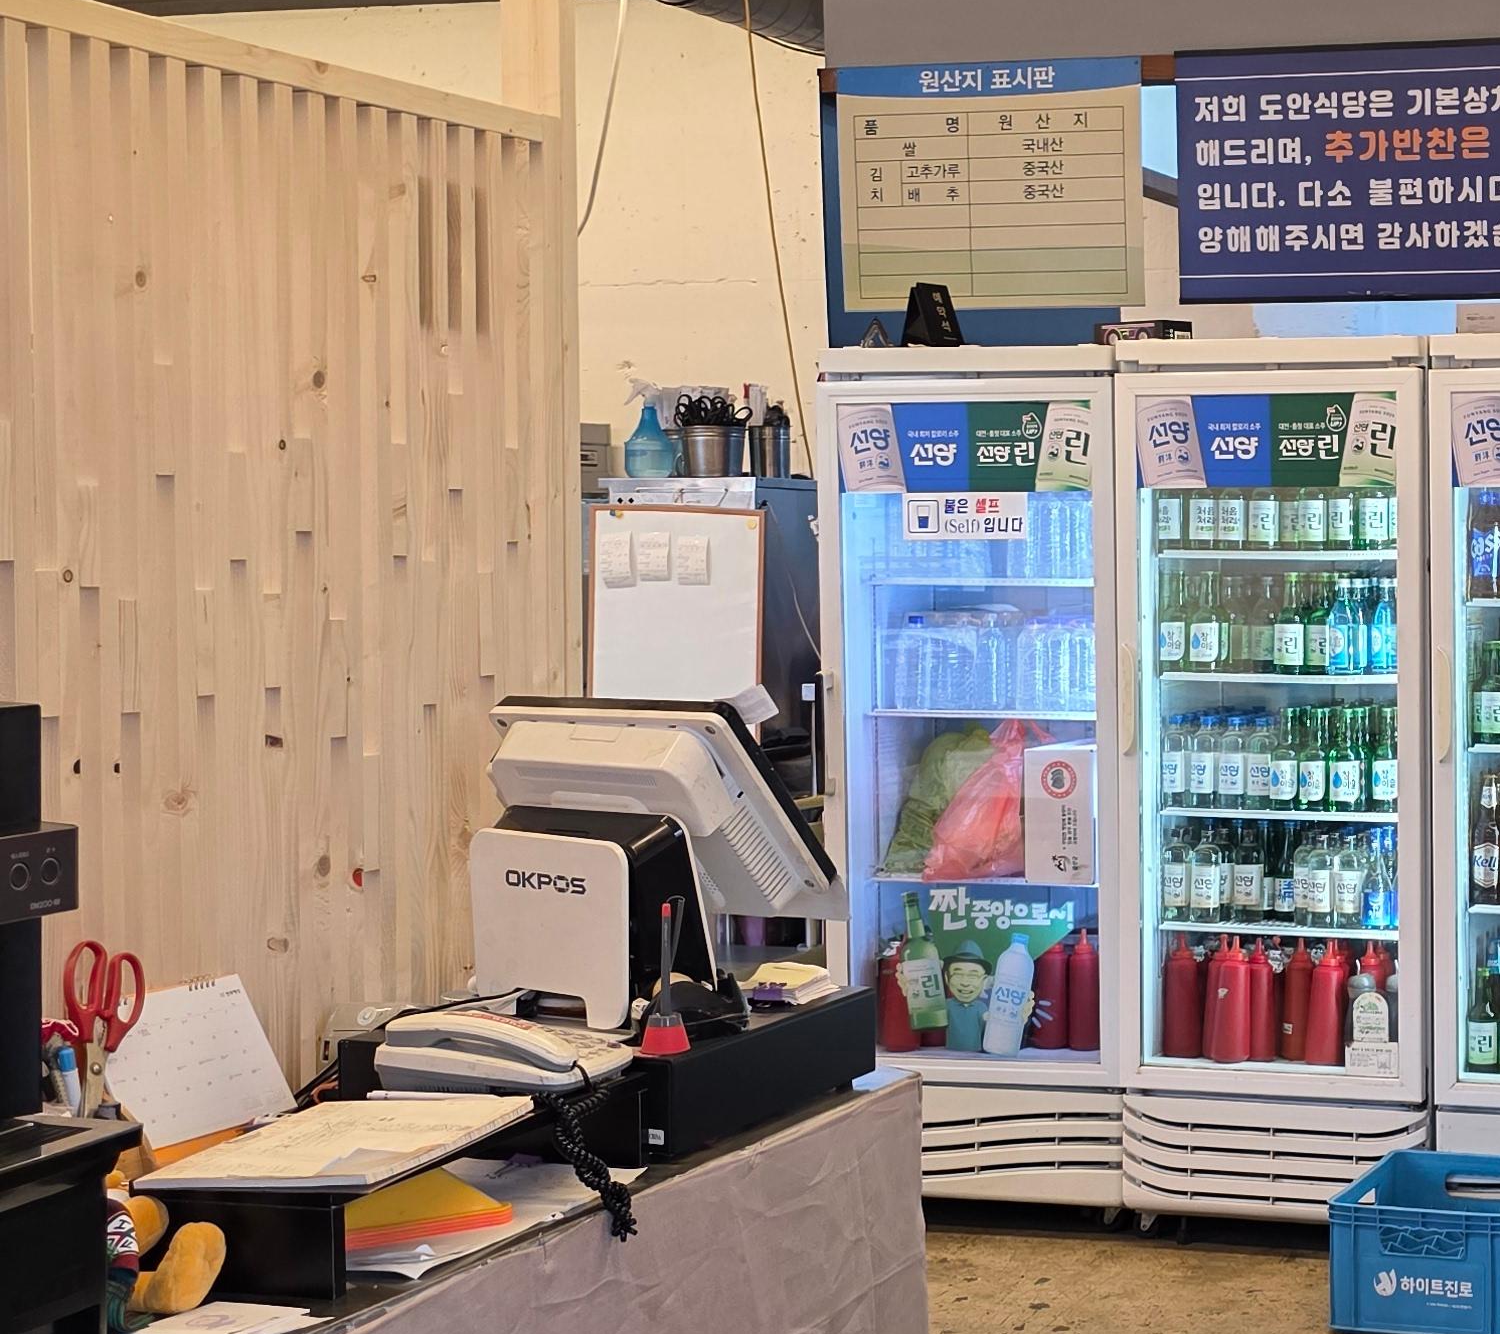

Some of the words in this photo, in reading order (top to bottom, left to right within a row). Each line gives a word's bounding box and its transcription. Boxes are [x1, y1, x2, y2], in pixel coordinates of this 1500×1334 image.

[919, 69, 982, 93] 원산지
[991, 66, 1055, 89] 표시판
[1195, 95, 1246, 122] 저희
[1259, 89, 1394, 120] 도안식당은
[864, 119, 878, 135] 품
[947, 116, 959, 132] 명
[999, 114, 1013, 130] 원
[1035, 113, 1050, 129] 산
[1074, 111, 1088, 128] 지
[902, 141, 917, 157] 쌀
[1023, 137, 1064, 152] 국내산
[1196, 137, 1312, 167] 해드리며,
[1325, 126, 1490, 163] 추가반찬은
[906, 164, 961, 179] 고추가루
[1023, 160, 1064, 176] 중국산
[908, 187, 920, 201] 배
[947, 186, 960, 200] 추
[1023, 184, 1065, 199] 중국산
[1197, 182, 1286, 210] 입니다.
[1299, 180, 1352, 207] 다소
[1199, 223, 1365, 253] 양해해주시면
[850, 428, 890, 455] 선양
[1149, 421, 1190, 448] 선양
[1371, 422, 1396, 459] 린
[910, 443, 957, 466] 선양
[977, 446, 1011, 465] 선양
[1014, 442, 1036, 466] 린
[1066, 430, 1090, 465] 린
[1210, 437, 1258, 459] 선양
[1279, 439, 1315, 458] 선양
[1318, 435, 1339, 459] 린
[944, 498, 968, 514] 물은
[976, 498, 1000, 513] 셀프
[945, 519, 980, 533] (Self)
[984, 517, 1023, 533] 입니다
[505, 869, 586, 895] OKPOS
[929, 887, 968, 931] 짠
[922, 974, 941, 1000] 린
[1400, 1275, 1473, 1298] 하이트진로
